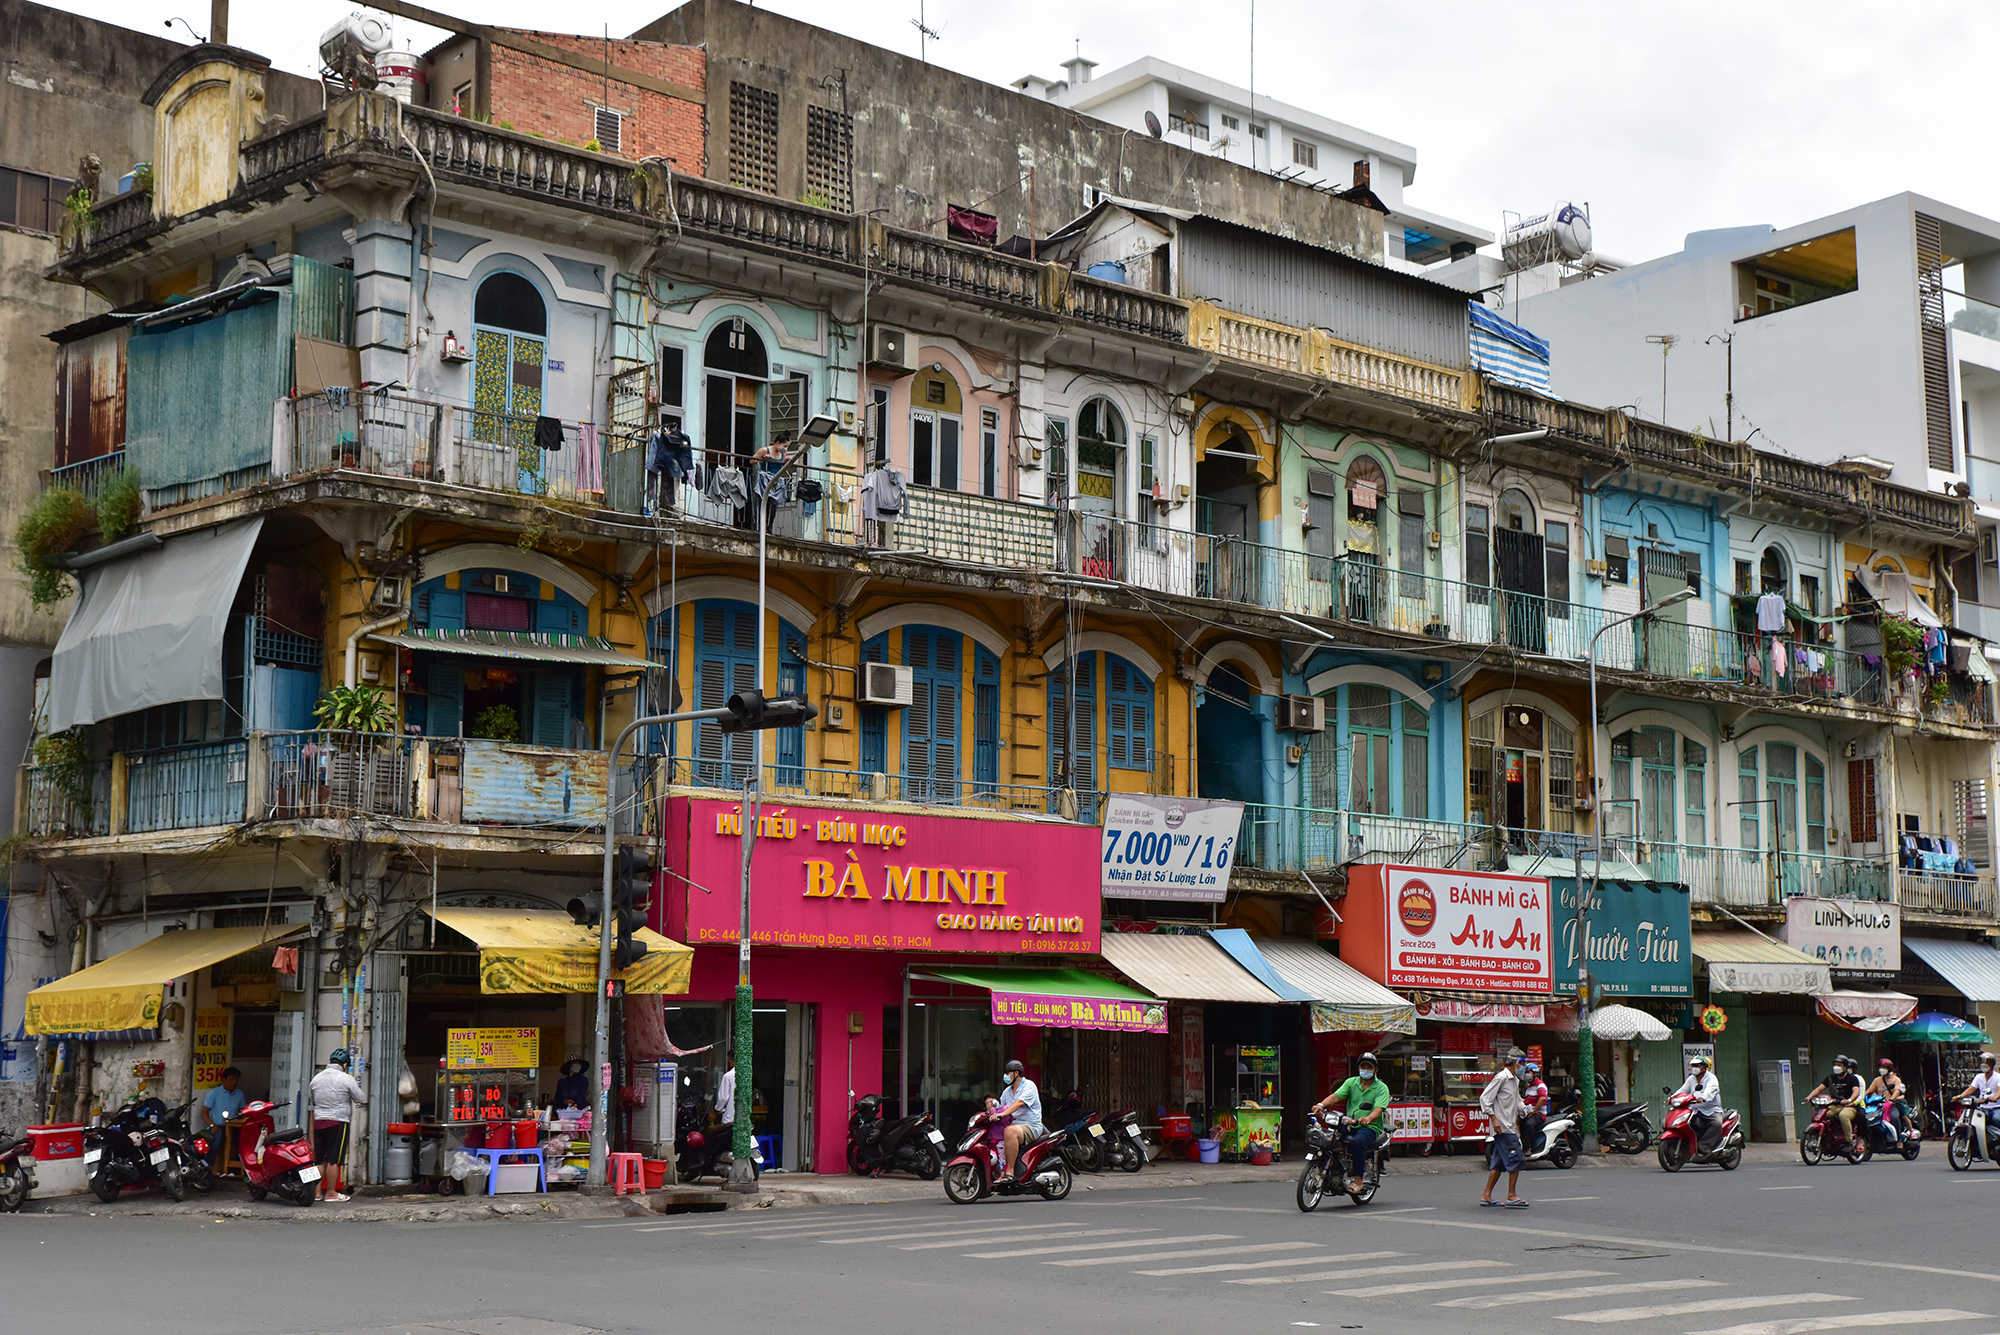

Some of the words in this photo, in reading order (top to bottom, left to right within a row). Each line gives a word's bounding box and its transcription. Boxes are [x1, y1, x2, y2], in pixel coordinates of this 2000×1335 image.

[817, 816, 856, 843] BÚN
[863, 824, 907, 850] MỌC
[1104, 830, 1172, 866] 7.000
[803, 849, 872, 899] BÀ
[882, 865, 1008, 905] MINH
[1108, 869, 1132, 882] Nhận
[1135, 870, 1152, 884] Đặt
[1154, 870, 1168, 882] Số
[1169, 872, 1196, 886] Lượng
[1199, 873, 1216, 884] Lớn
[1450, 883, 1493, 906] BÁNH
[1498, 886, 1514, 908] MÌ
[1520, 888, 1540, 910] GÀ
[1560, 887, 1602, 910] Coee
[937, 914, 977, 930] GIAO
[980, 911, 1024, 931] HÀNG
[1026, 913, 1056, 934] TẬN
[1815, 910, 1844, 927] LINH
[700, 928, 720, 940] ĐC:
[752, 930, 771, 942] 446
[774, 930, 796, 942] Trần
[798, 932, 825, 946] Hưng
[828, 934, 851, 946] Đạo,
[854, 935, 870, 946] P11,
[872, 935, 890, 947] Q5,
[892, 936, 906, 946] TP.
[908, 936, 932, 948] HCM
[1450, 914, 1494, 950] An
[1498, 918, 1541, 952] An
[1022, 940, 1035, 950] ĐT:
[1036, 940, 1056, 950] 0916
[1058, 940, 1068, 950] 37
[1070, 941, 1080, 951] 28
[1081, 942, 1091, 951] 37
[1400, 940, 1416, 948] Since
[1418, 940, 1436, 948] 2009
[1562, 918, 1629, 969] Phước
[1636, 921, 1680, 963] Tiến
[1406, 956, 1427, 964] BÁNH
[1428, 956, 1436, 965] MÌ
[1442, 956, 1454, 966] XÔI
[1461, 957, 1480, 968] BÁNH
[1482, 960, 1496, 968] BAO
[1502, 959, 1521, 970] BÁNH
[1522, 960, 1534, 970] GIÒ
[1416, 975, 1429, 984] Trần
[1430, 976, 1446, 986] Hưng
[1446, 977, 1459, 986] Đạo,
[1460, 978, 1474, 986] P.10,
[1476, 978, 1485, 986] Q.5
[1490, 979, 1512, 988] Hotline:
[1538, 981, 1548, 989] 822
[998, 998, 1008, 1012] HỦ
[1010, 998, 1028, 1014] TIẾU
[1034, 1002, 1050, 1014] BÚN
[1052, 1004, 1068, 1017] MỌC
[1070, 1002, 1094, 1020] Bà
[1099, 1004, 1142, 1024] Minh
[452, 1030, 478, 1040] TUYẾT
[516, 1029, 536, 1038] 35K
[208, 1049, 226, 1064] VIÊN
[480, 1042, 494, 1056] 35K
[1702, 1046, 1712, 1056] TIẾN
[196, 1067, 225, 1082] 35K
[1248, 1128, 1270, 1142] MÍA
